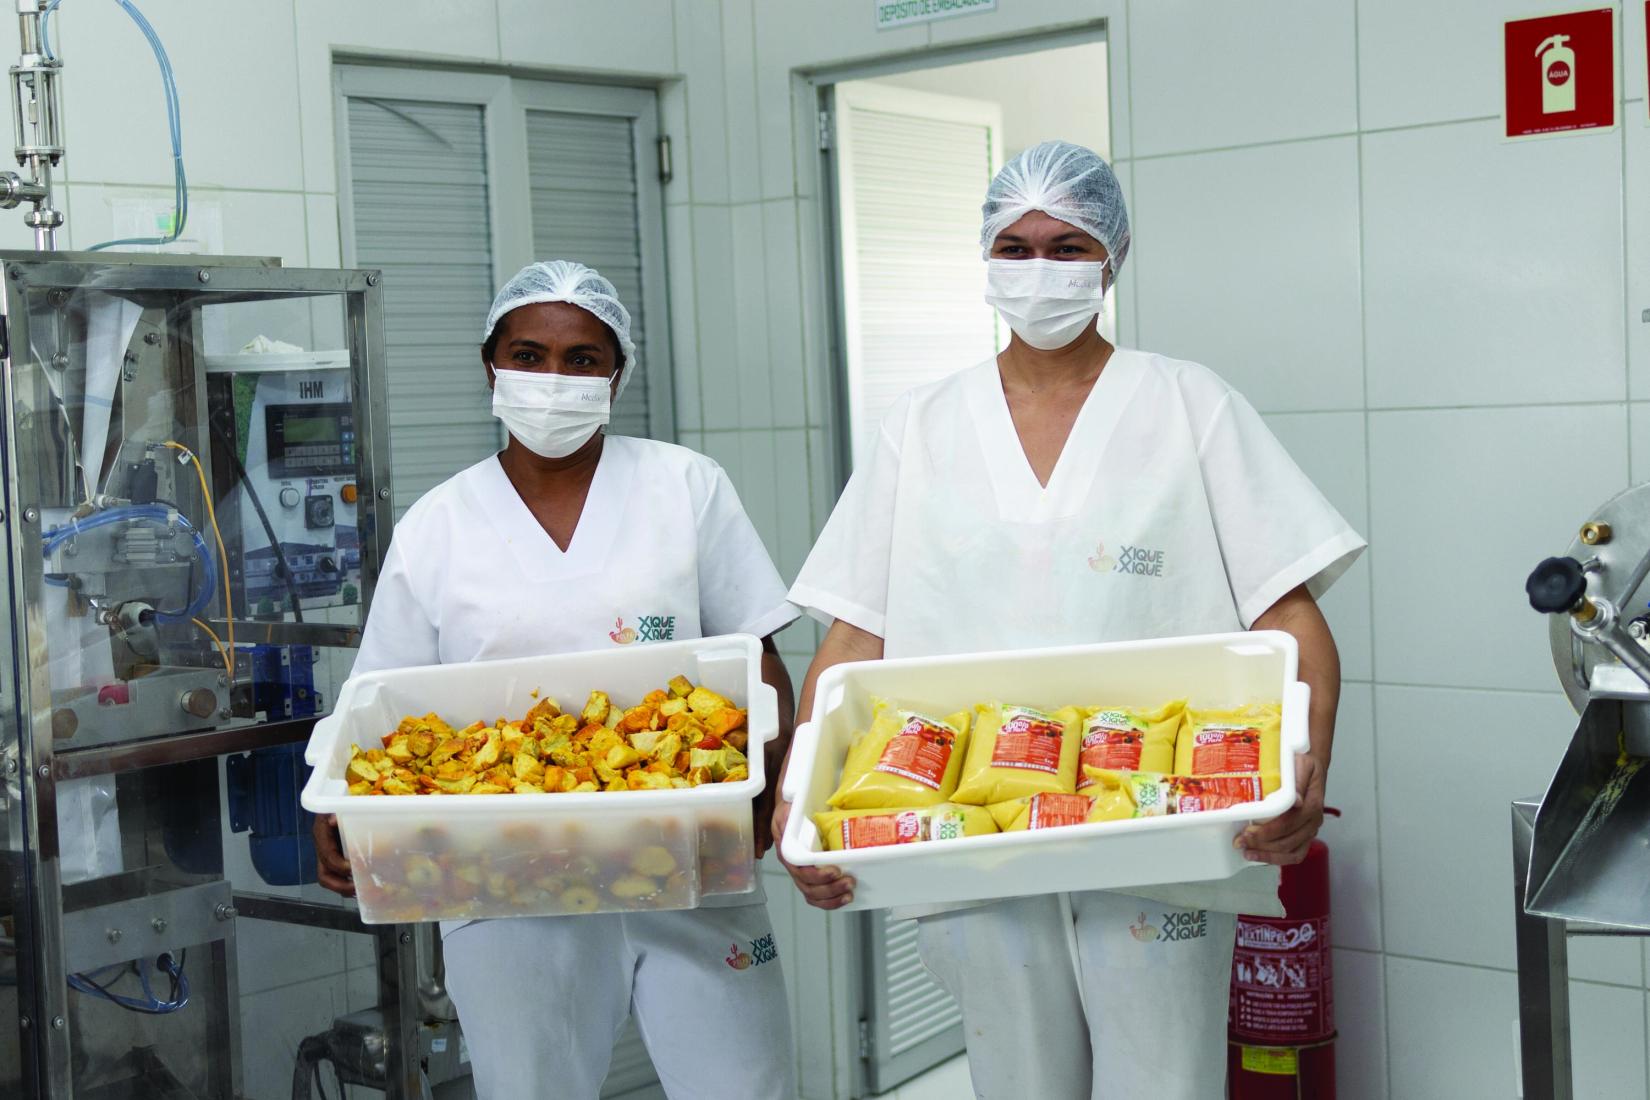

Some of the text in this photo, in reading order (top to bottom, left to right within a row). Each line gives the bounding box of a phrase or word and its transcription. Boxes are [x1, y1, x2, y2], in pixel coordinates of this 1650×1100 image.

[299, 381, 324, 399] IHM
[1119, 545, 1165, 563] XIQUE
[1118, 560, 1163, 577] XIQUE
[638, 616, 675, 629] XIQUE
[639, 628, 674, 642] XIQUE
[1163, 910, 1208, 928] XIQUE
[1162, 923, 1207, 942] XIQUE
